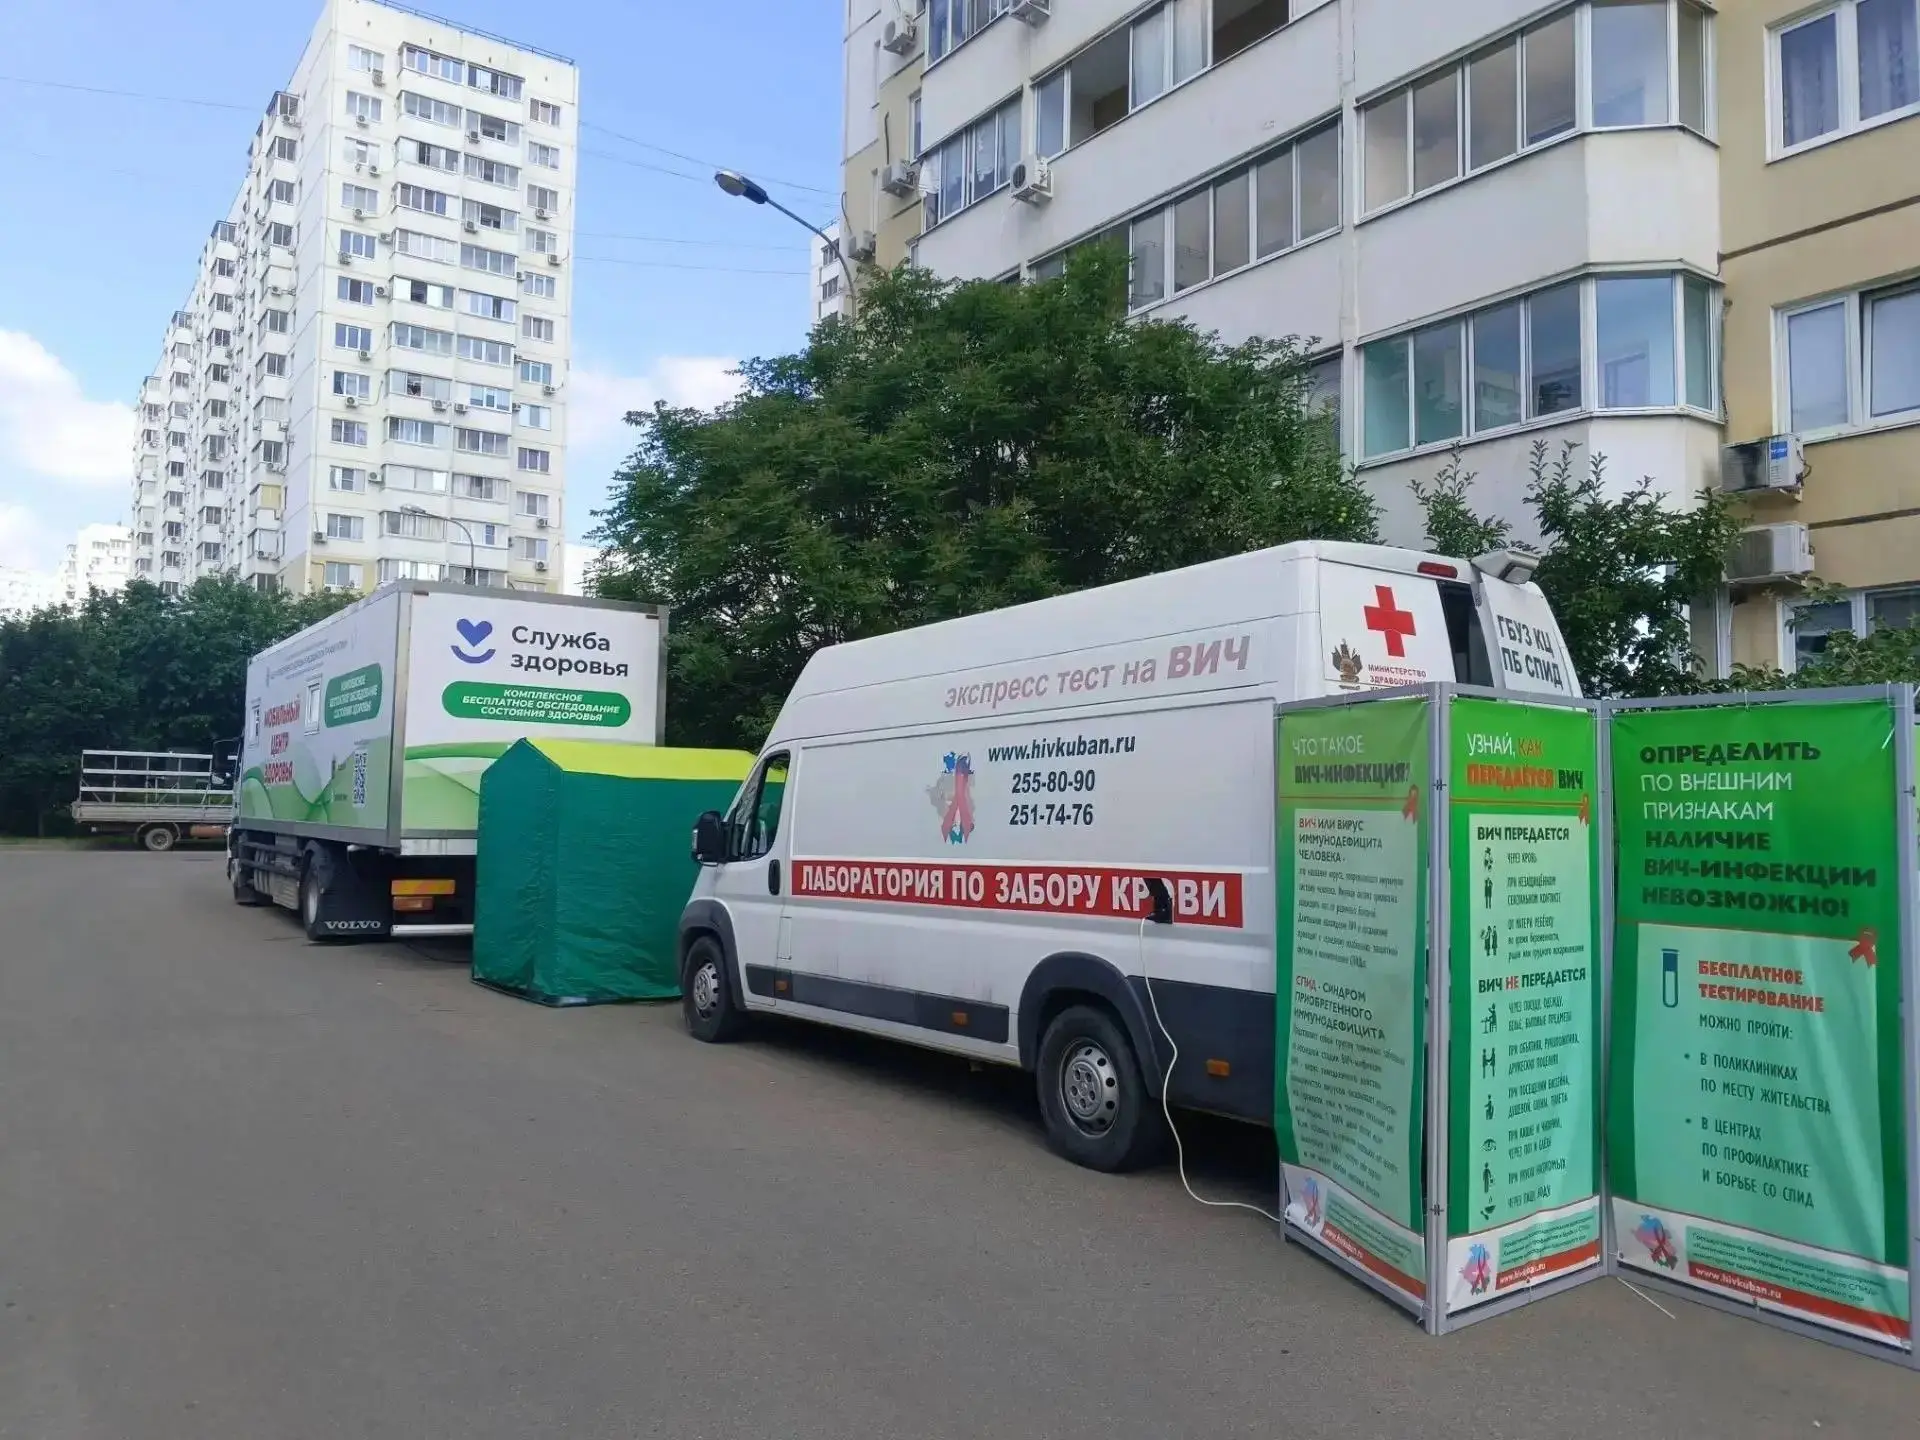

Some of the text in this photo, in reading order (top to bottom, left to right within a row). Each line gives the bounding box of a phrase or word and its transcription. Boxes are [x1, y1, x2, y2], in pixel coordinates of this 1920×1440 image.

[511, 625, 611, 651] Служба
[1497, 615, 1532, 646] ГБУЗ
[510, 653, 629, 677] здоровья
[944, 635, 1250, 708] экспресс тест на ВИЧ
[1368, 664, 1427, 678] МИНИСТЕРСТВО
[1501, 647, 1563, 690] ПБ СПИД
[462, 695, 620, 714] БЕСПЛАТНОЕ ОБСЛЕДОВАНИЕ
[503, 689, 583, 702] КОМПЛЕКСНОЕ
[481, 706, 602, 721] СОСТОЯНИЯ ЗДОРОВЬЯ
[988, 734, 1136, 762] www.hivkuban.ru
[1292, 735, 1364, 756] ЧТО ТАКОЕ
[1467, 732, 1543, 759] УЗНАЙ, КАК
[1640, 741, 1822, 766] ОПРЕДЕЛИТЬ
[1011, 769, 1096, 794] 255-80-90
[1558, 768, 1584, 790] ВИЧ
[1641, 772, 1792, 792] ПО ВНЕШНИМ
[1009, 803, 1093, 826] 251-74-76
[1643, 801, 1774, 820] ПРИЗНАКАМ
[1299, 817, 1364, 833] ВИЧ ИЛИ ВИРУС
[1477, 826, 1570, 844] ВИЧ ПЕРЕДАЕТСЯ
[1299, 833, 1383, 850] ИММУНОДЕФИЦИТА
[1645, 830, 1771, 851] НАЛИЧИЕ
[1299, 849, 1341, 863] ЧЕЛОВЕКА
[1644, 858, 1877, 889] ВИЧ-ИНФЕКЦИИ
[800, 865, 944, 900] ЛАБОРАТОРИЯ
[951, 871, 985, 902] ПО
[995, 872, 1102, 909] ЗАБОРУ
[1642, 886, 1850, 917] НЕВОЗМОЖНО!
[324, 920, 381, 930] VOLVO
[1478, 967, 1586, 993] ВИЧ НЕ ПЕРЕДАЕТСЯ
[1698, 960, 1804, 984] БЕСПЛАТНОЕ
[1296, 975, 1317, 992] СПИД
[1322, 982, 1366, 1002] СИНДРОМ
[1698, 984, 1825, 1013] ТЕСТИРОВАНИЕ
[1295, 991, 1373, 1021] ПРИОБРЕТЕННОГО
[1294, 1007, 1386, 1041] ИММУНОДЕФИЦИТА
[1699, 1013, 1793, 1041] МОЖНО ПРОЙТИ:
[1700, 1052, 1798, 1082] В ПОЛИКЛИНИКАХ
[1701, 1078, 1831, 1115] ПО МЕСТУ ЖИТЕЛЬСТВА
[1701, 1116, 1762, 1142] В ЦЕНТРАХ
[1702, 1143, 1809, 1178] ПО ПРОФИЛАКТИКЕ
[1703, 1168, 1815, 1209] И БОРЬБЕ СО СПИД
[1695, 1268, 1782, 1299] www.hivkuban.ru
